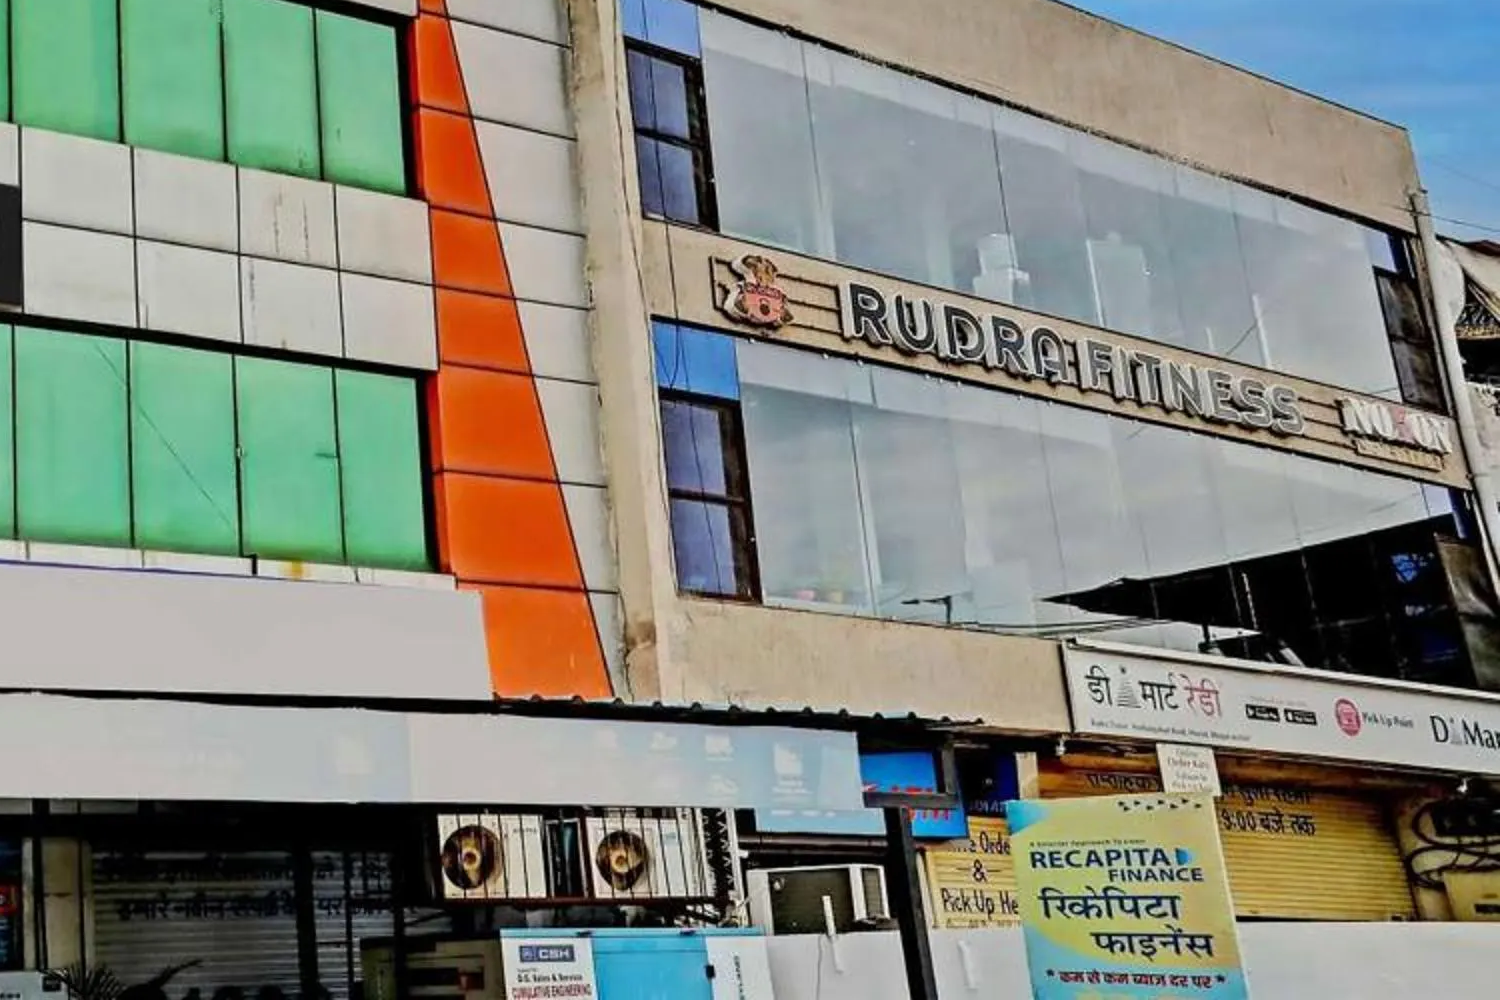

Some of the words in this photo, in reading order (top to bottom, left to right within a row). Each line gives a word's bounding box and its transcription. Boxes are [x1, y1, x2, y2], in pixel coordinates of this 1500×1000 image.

[838, 280, 1077, 387] RUDRA
[1076, 337, 1304, 435] FITNESS
[1085, 665, 1112, 706] डी
[1138, 672, 1179, 711] मार्ट
[979, 831, 1011, 856] Orde
[1030, 848, 1170, 868] RECAPITA
[973, 859, 988, 882] &
[1109, 868, 1204, 882] FINANCE
[941, 887, 973, 914] Pick
[974, 887, 995, 920] Up
[999, 887, 1019, 915] He
[1038, 886, 1181, 919] रिकेपिटा
[1090, 925, 1214, 961] फाइनेंस
